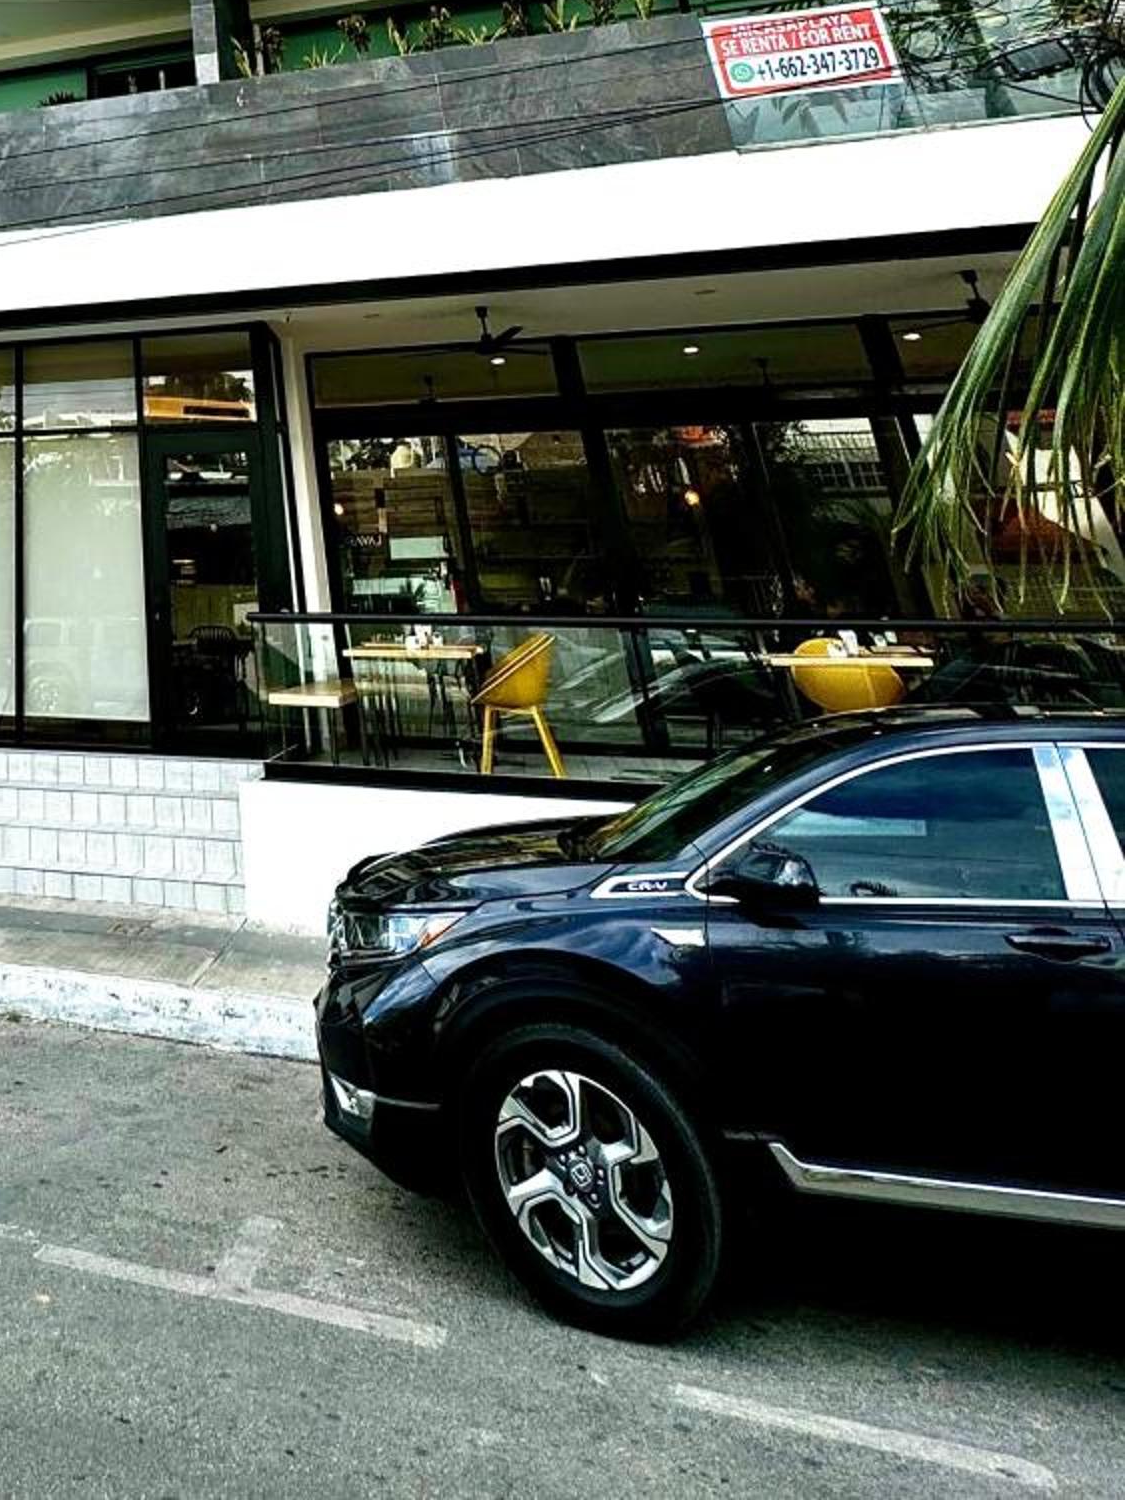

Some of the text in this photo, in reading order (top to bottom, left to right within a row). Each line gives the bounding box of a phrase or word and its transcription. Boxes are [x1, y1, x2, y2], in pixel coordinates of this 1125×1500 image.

[720, 39, 740, 57] SE
[741, 33, 789, 54] RENTA
[800, 29, 829, 47] FOR
[832, 23, 872, 42] RENT
[757, 47, 880, 82] +1-662-347-3729
[627, 881, 667, 891] CR-V
